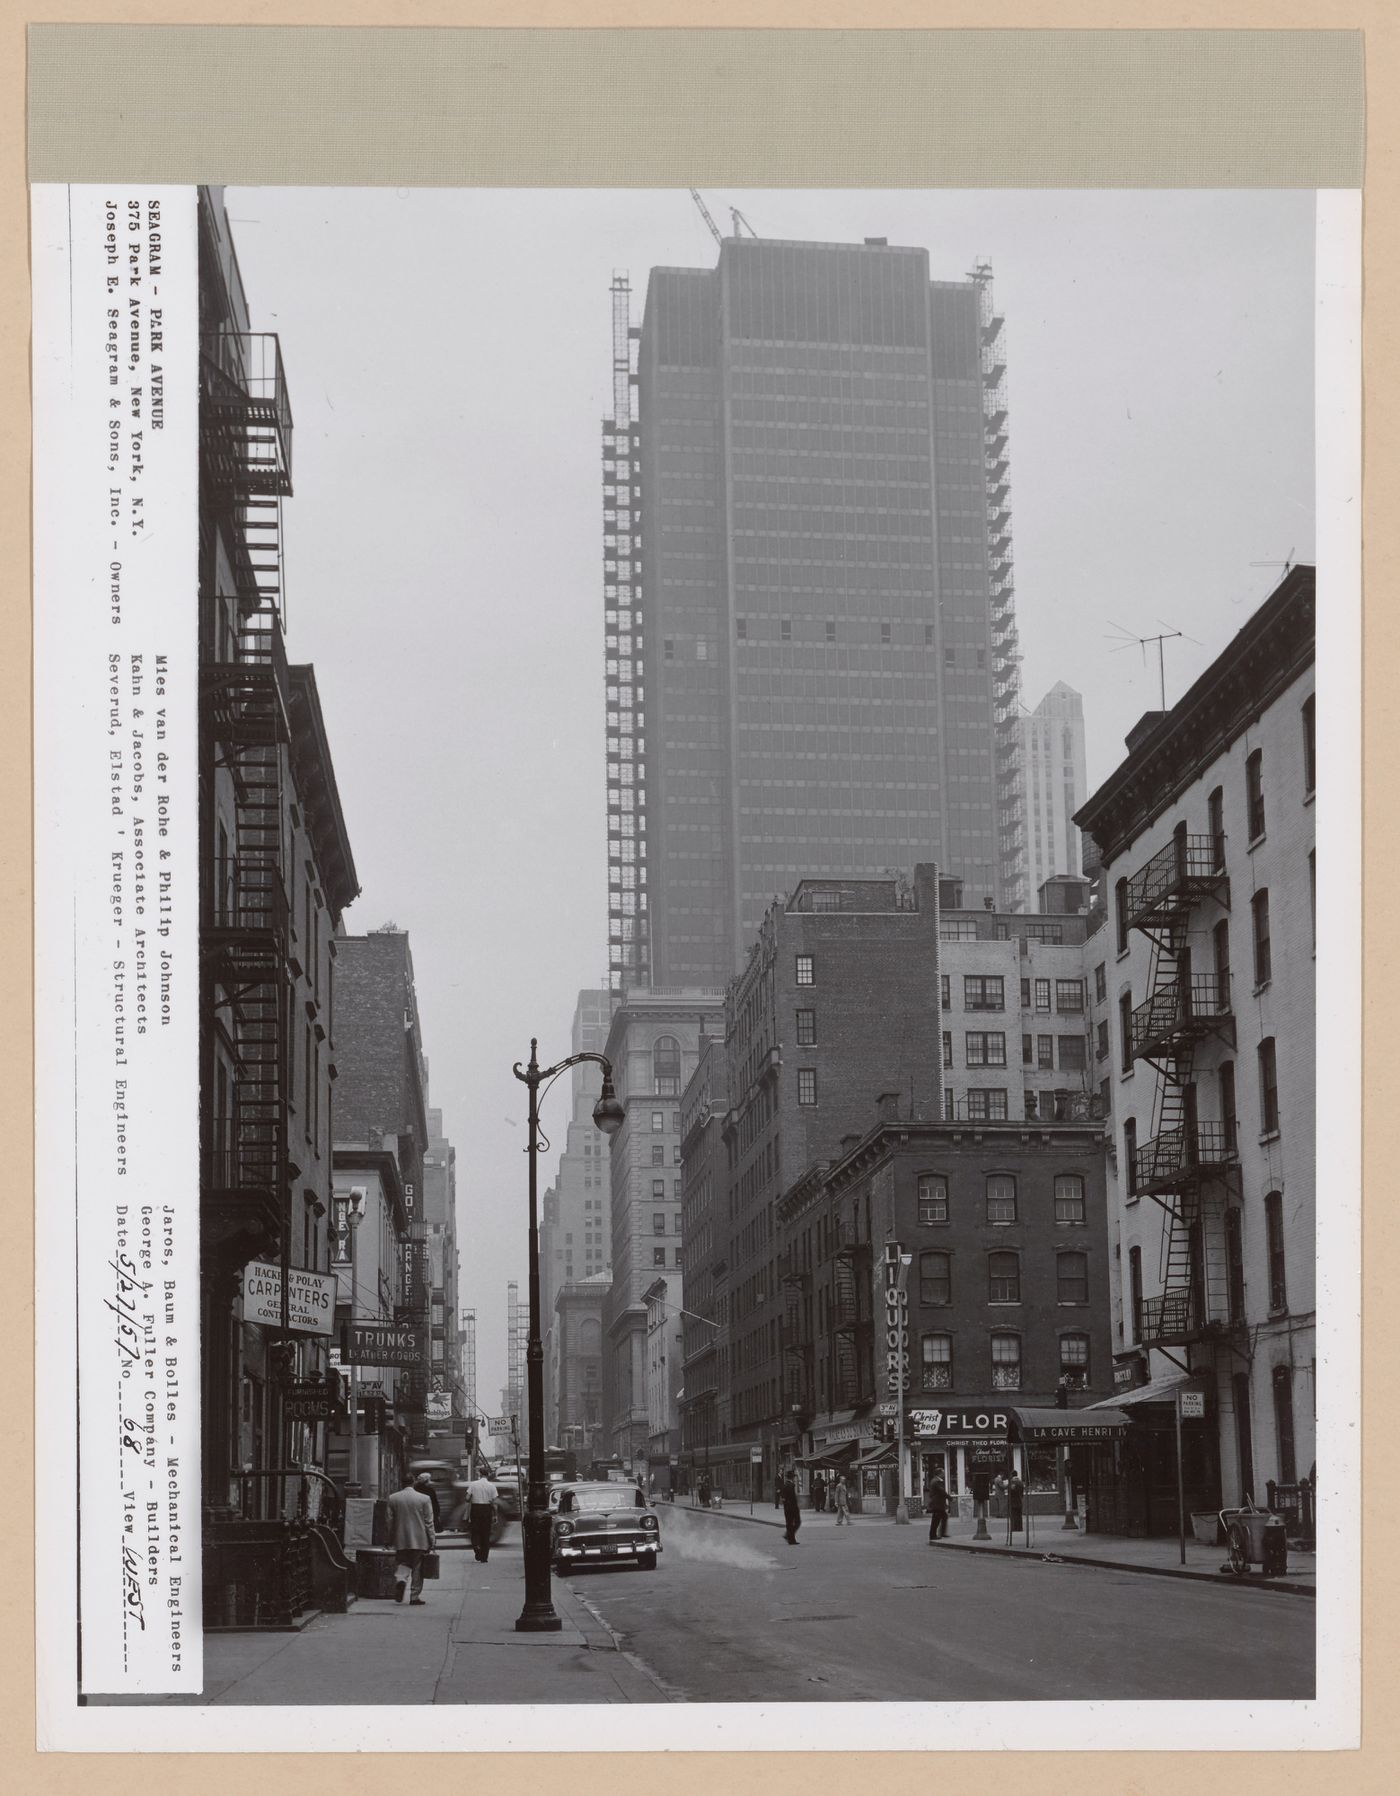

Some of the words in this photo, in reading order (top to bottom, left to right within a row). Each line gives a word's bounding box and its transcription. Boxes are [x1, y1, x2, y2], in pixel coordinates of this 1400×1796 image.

[103, 200, 119, 265] Joseph
[128, 200, 140, 232] 375
[148, 200, 162, 276] SEAGRAM
[107, 276, 119, 294] E.
[129, 243, 141, 286] Park
[106, 308, 120, 385] Seagram
[127, 298, 141, 372] Avenue,
[150, 308, 163, 353] PARK
[109, 398, 121, 408] &
[131, 387, 142, 418] New
[151, 364, 163, 430] AVENUE
[108, 420, 122, 471] Sons,
[129, 430, 144, 482] York,
[109, 488, 122, 526] Inc.
[131, 498, 144, 536] N.Y.
[110, 561, 122, 625] Owners
[107, 654, 122, 736] Severud,
[131, 654, 143, 696] Kahn
[155, 655, 168, 696] Mies
[132, 708, 144, 718] &
[157, 708, 168, 740] van
[110, 750, 124, 815] Elstad
[130, 729, 146, 802] Jacobs,
[157, 752, 169, 783] der
[157, 795, 170, 837] Rohe
[134, 817, 147, 915] Associate
[159, 849, 171, 860] &
[109, 852, 125, 927] Krueger
[157, 871, 172, 937] Philip
[135, 928, 149, 1034] Architects
[161, 950, 173, 1026] Johnson
[113, 960, 127, 1065] Structural
[113, 1079, 129, 1176] Engineers
[115, 1205, 129, 1249] Date
[138, 1205, 153, 1269] George
[160, 1205, 175, 1266] Jaros,
[141, 1281, 154, 1299] A.
[248, 1279, 330, 1309] CARPNTERS
[255, 1266, 284, 1281] HACKE
[288, 1273, 295, 1283] &
[296, 1276, 325, 1289] POLAY
[164, 1280, 176, 1324] Baum
[257, 1308, 319, 1326] CONTACTORS
[267, 1300, 310, 1314] GERAL
[885, 1246, 900, 1391] LIQUORS
[141, 1314, 156, 1379] Fuller
[165, 1336, 178, 1347] &
[349, 1349, 388, 1361] LEATHER
[355, 1331, 416, 1348] TRUNKS
[119, 1359, 133, 1380] No
[165, 1357, 179, 1421] Bolles
[372, 1381, 383, 1390] AV
[121, 1417, 145, 1455] 68
[142, 1390, 157, 1468] Company
[913, 1411, 939, 1422] Christ
[1034, 1428, 1046, 1437] LA
[1051, 1428, 1076, 1437] CAVE
[1081, 1427, 1112, 1437] HENRI
[1118, 1427, 1128, 1437] IV
[122, 1490, 137, 1535] View
[167, 1457, 181, 1563] Mechanical
[146, 1501, 160, 1586] Builders
[122, 1546, 146, 1632] WEST
[167, 1576, 183, 1672] Engineers
